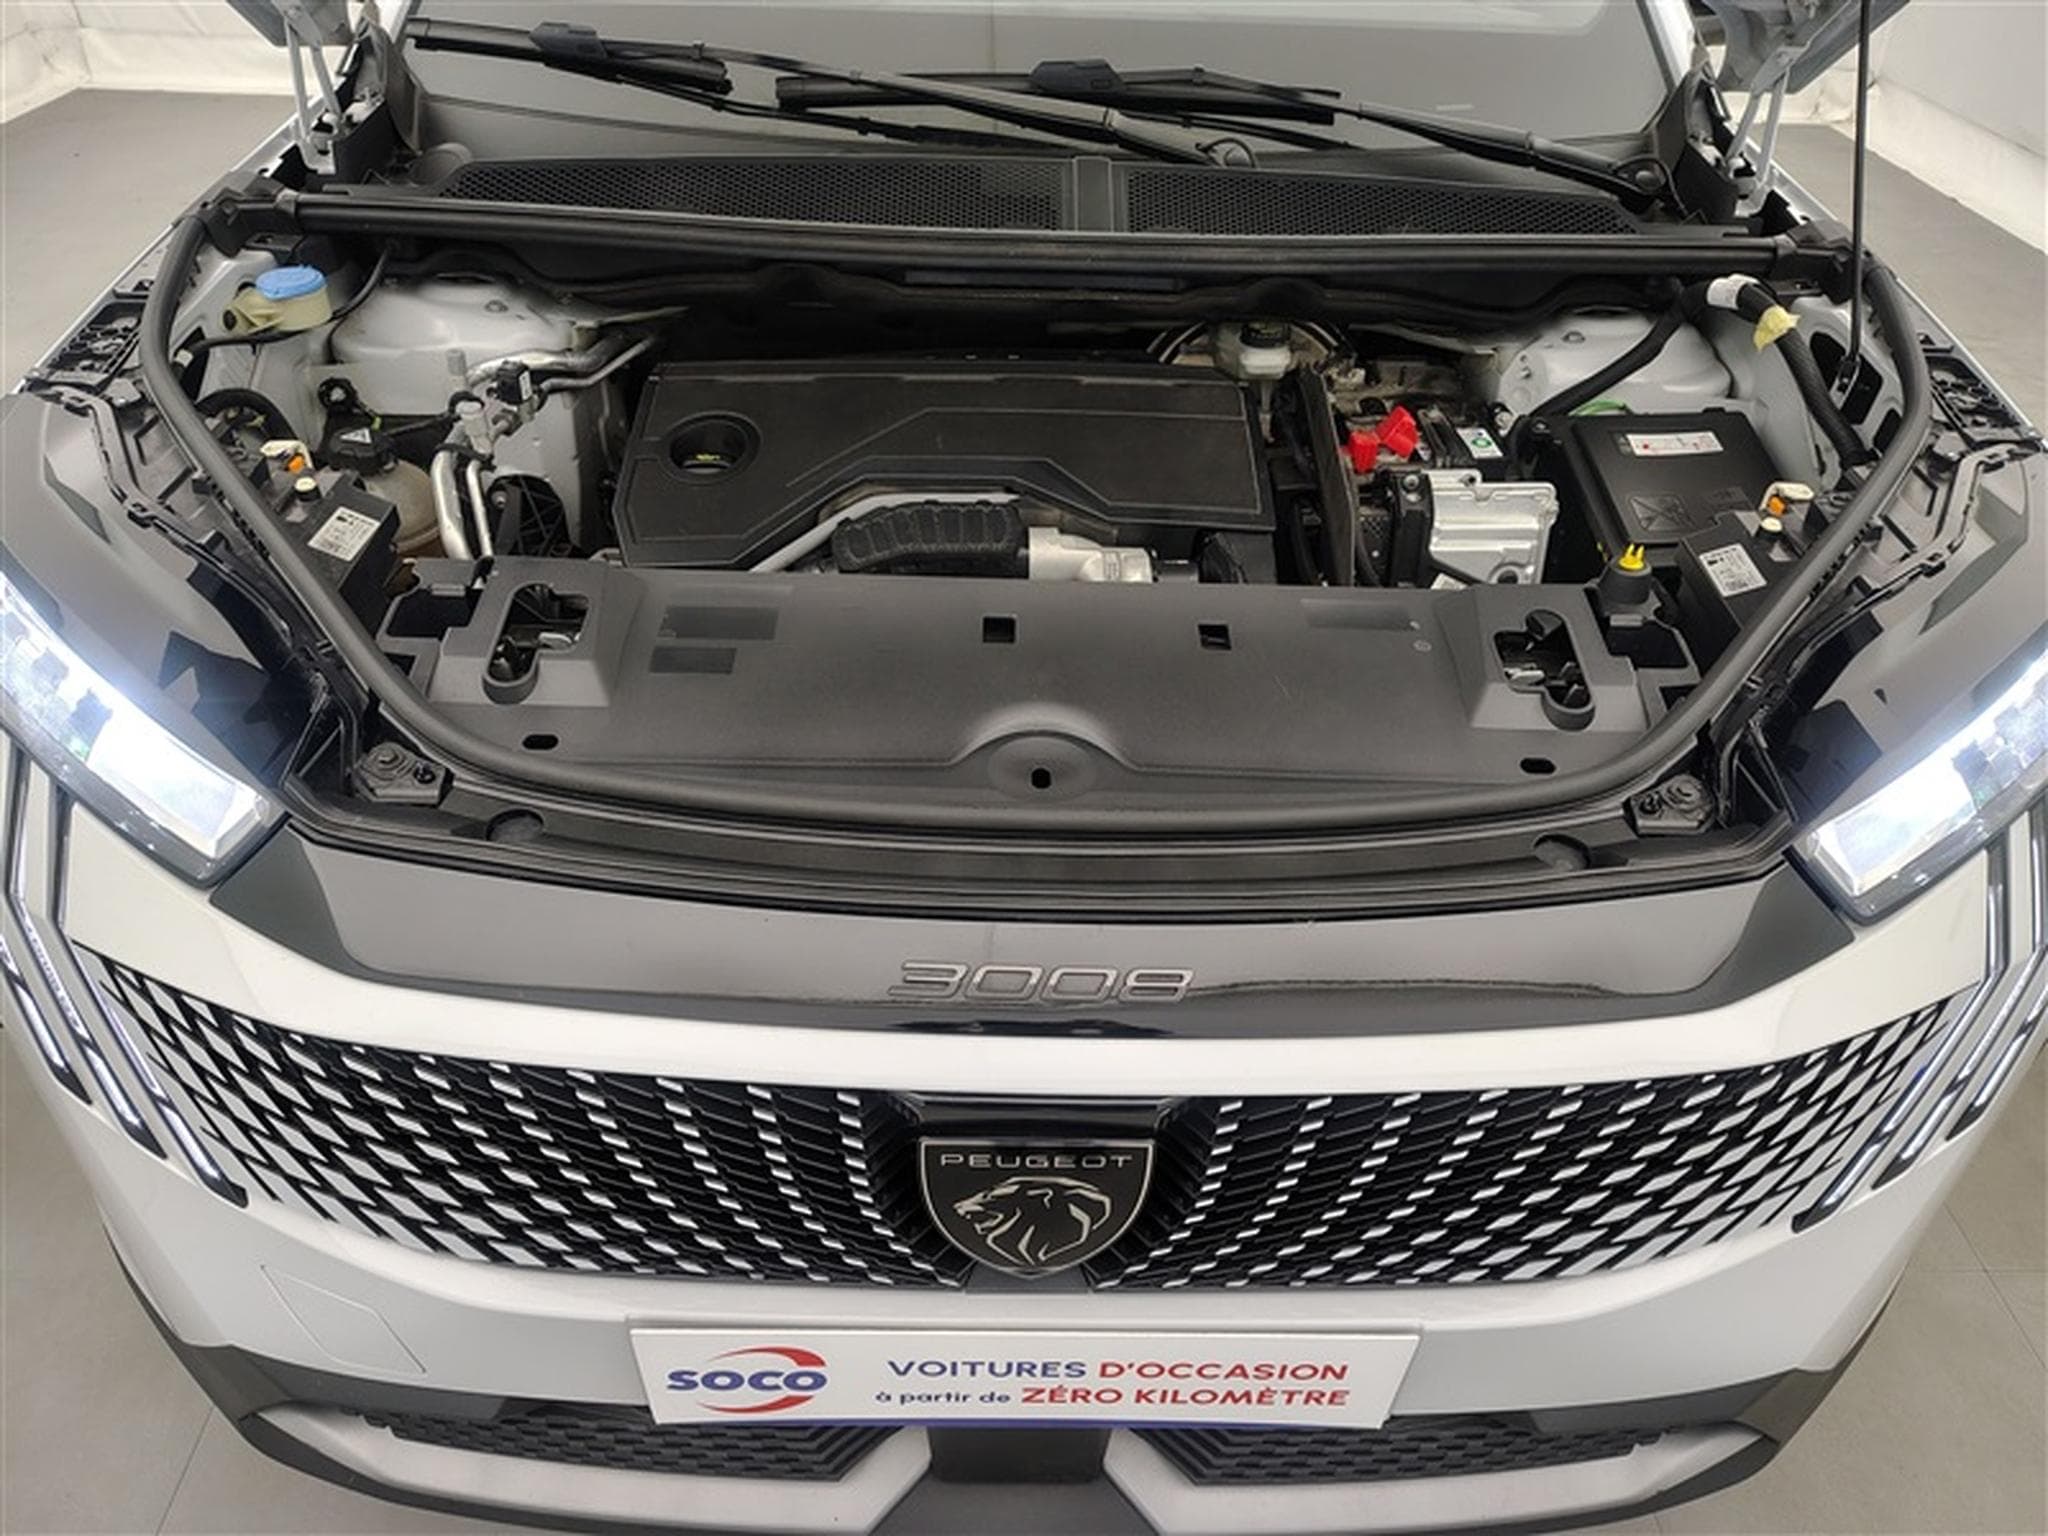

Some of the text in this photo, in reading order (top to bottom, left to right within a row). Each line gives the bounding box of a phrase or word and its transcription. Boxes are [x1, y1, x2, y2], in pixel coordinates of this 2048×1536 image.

[888, 960, 1195, 1002] 3008
[940, 1154, 1134, 1169] PEUGEOT
[667, 1369, 828, 1392] SOCO
[887, 1360, 1349, 1381] VOITURES D'OCCASION
[875, 1385, 1350, 1406] à partir de ZÉRO KILOMÈTRE
